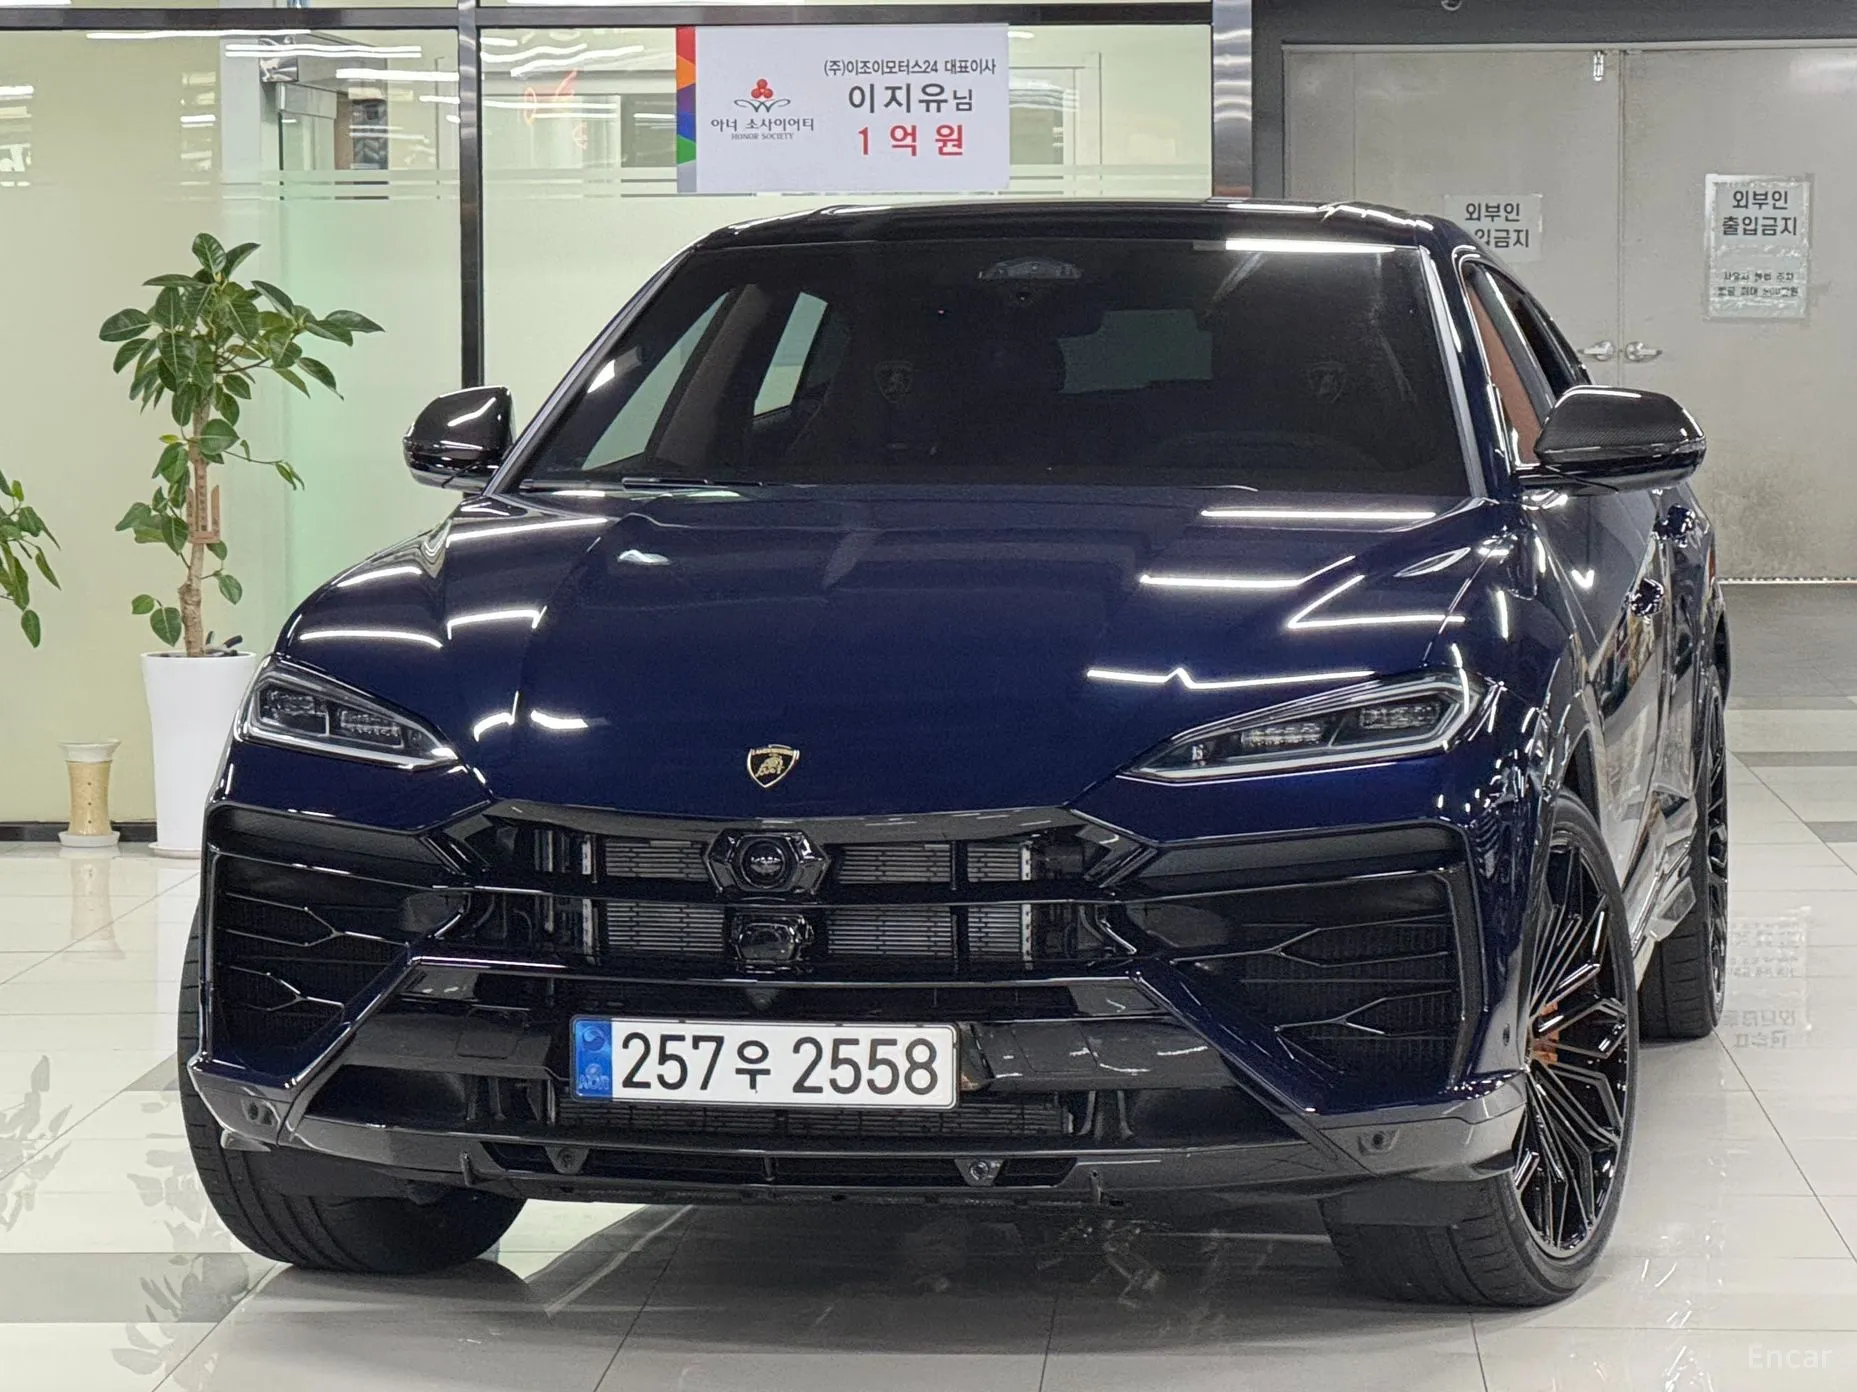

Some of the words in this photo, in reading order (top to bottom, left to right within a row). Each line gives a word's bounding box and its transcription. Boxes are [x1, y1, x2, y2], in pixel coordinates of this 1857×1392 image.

[824, 58, 938, 76] (주)이조이모터스24
[944, 58, 997, 75] 대표이사
[848, 83, 974, 114] 이지유님
[710, 117, 738, 132] 아너
[745, 117, 815, 132] 소사이어티
[731, 132, 759, 141] HONOR
[761, 132, 795, 141] SOCIETY
[1732, 190, 1789, 211] 외부인
[1465, 202, 1521, 222] 외부인
[1722, 216, 1798, 237] 출입금지
[1474, 228, 1530, 248] 입금지
[621, 1031, 771, 1093] 257우
[792, 1036, 938, 1096] 2558
